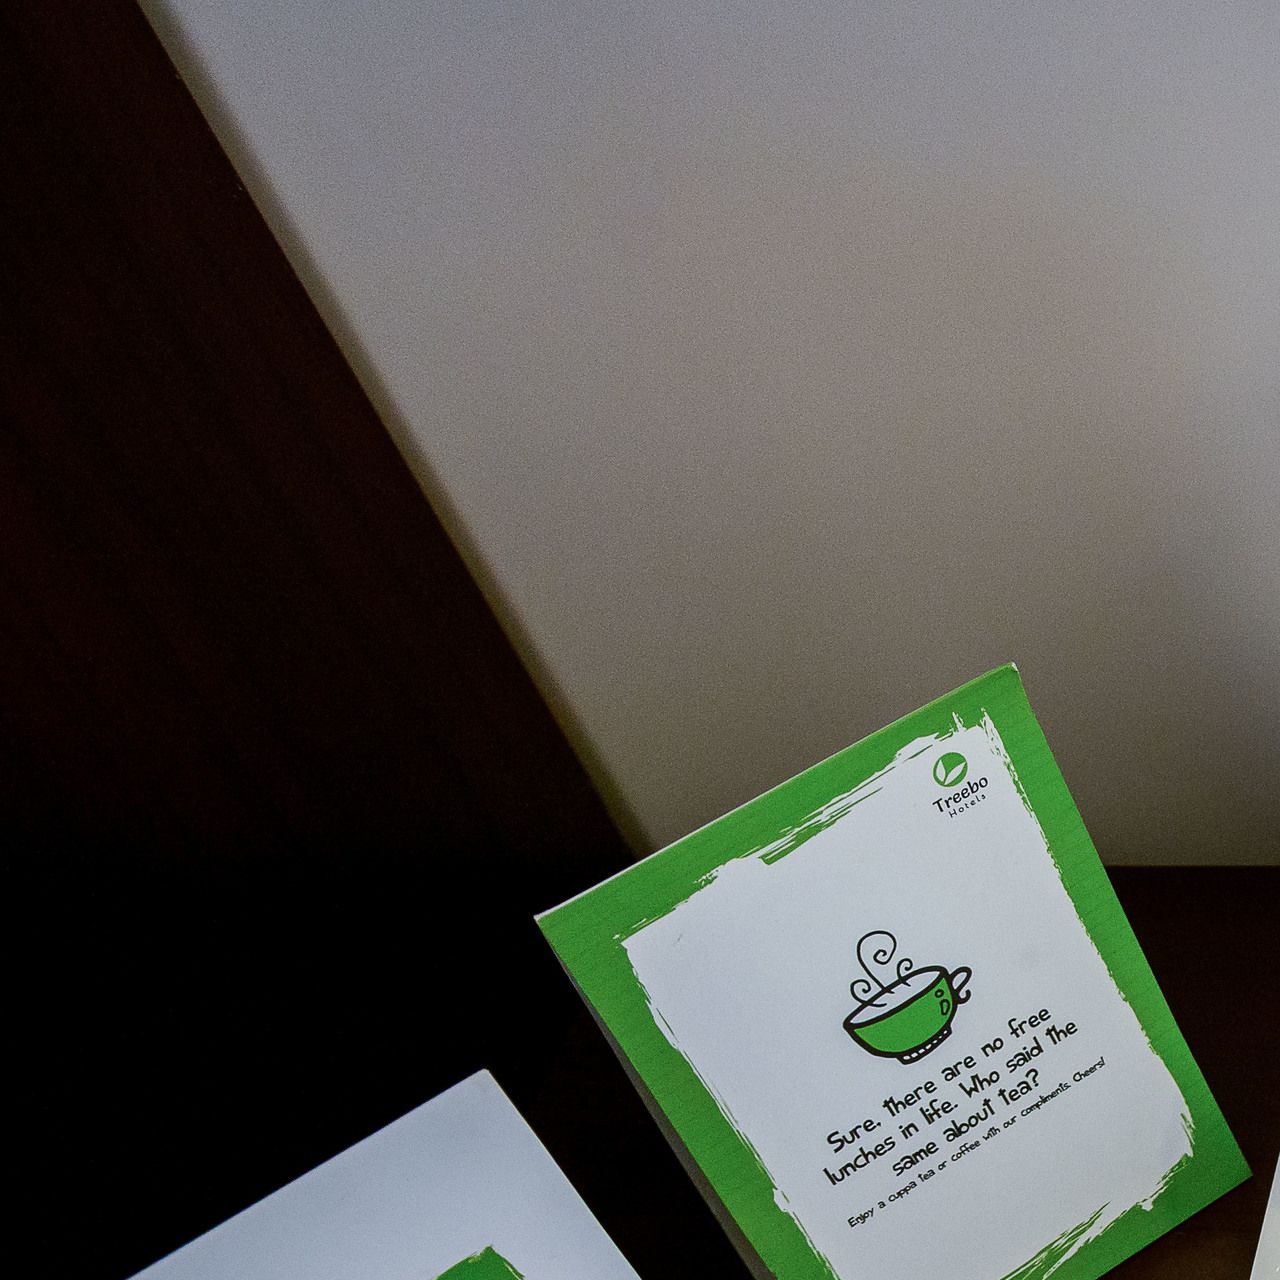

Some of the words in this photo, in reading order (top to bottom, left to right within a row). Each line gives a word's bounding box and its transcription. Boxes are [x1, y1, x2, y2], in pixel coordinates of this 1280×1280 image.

[932, 777, 988, 812] Treebo
[947, 794, 986, 818] Hotels
[823, 1136, 896, 1185] lunches
[898, 1123, 919, 1139] in
[919, 1099, 958, 1125] life.
[958, 1071, 1000, 1098] Who
[1006, 1036, 1044, 1073] said
[1045, 1022, 1078, 1045] the
[827, 1119, 881, 1153] Sure,
[882, 1081, 937, 1117] there
[941, 1056, 977, 1082] are
[981, 1038, 1004, 1057] no
[1008, 1009, 1051, 1038] free
[892, 1142, 939, 1176] same
[943, 1098, 995, 1142] about
[998, 1068, 1039, 1106] tea?
[847, 1207, 874, 1228] Enjoy
[877, 1201, 886, 1209] a
[888, 1181, 917, 1202] cuppa
[918, 1169, 936, 1182] tea
[938, 1160, 947, 1171] or
[951, 1140, 981, 1161] coffee
[982, 1126, 1001, 1141] with
[1003, 1116, 1017, 1129] our
